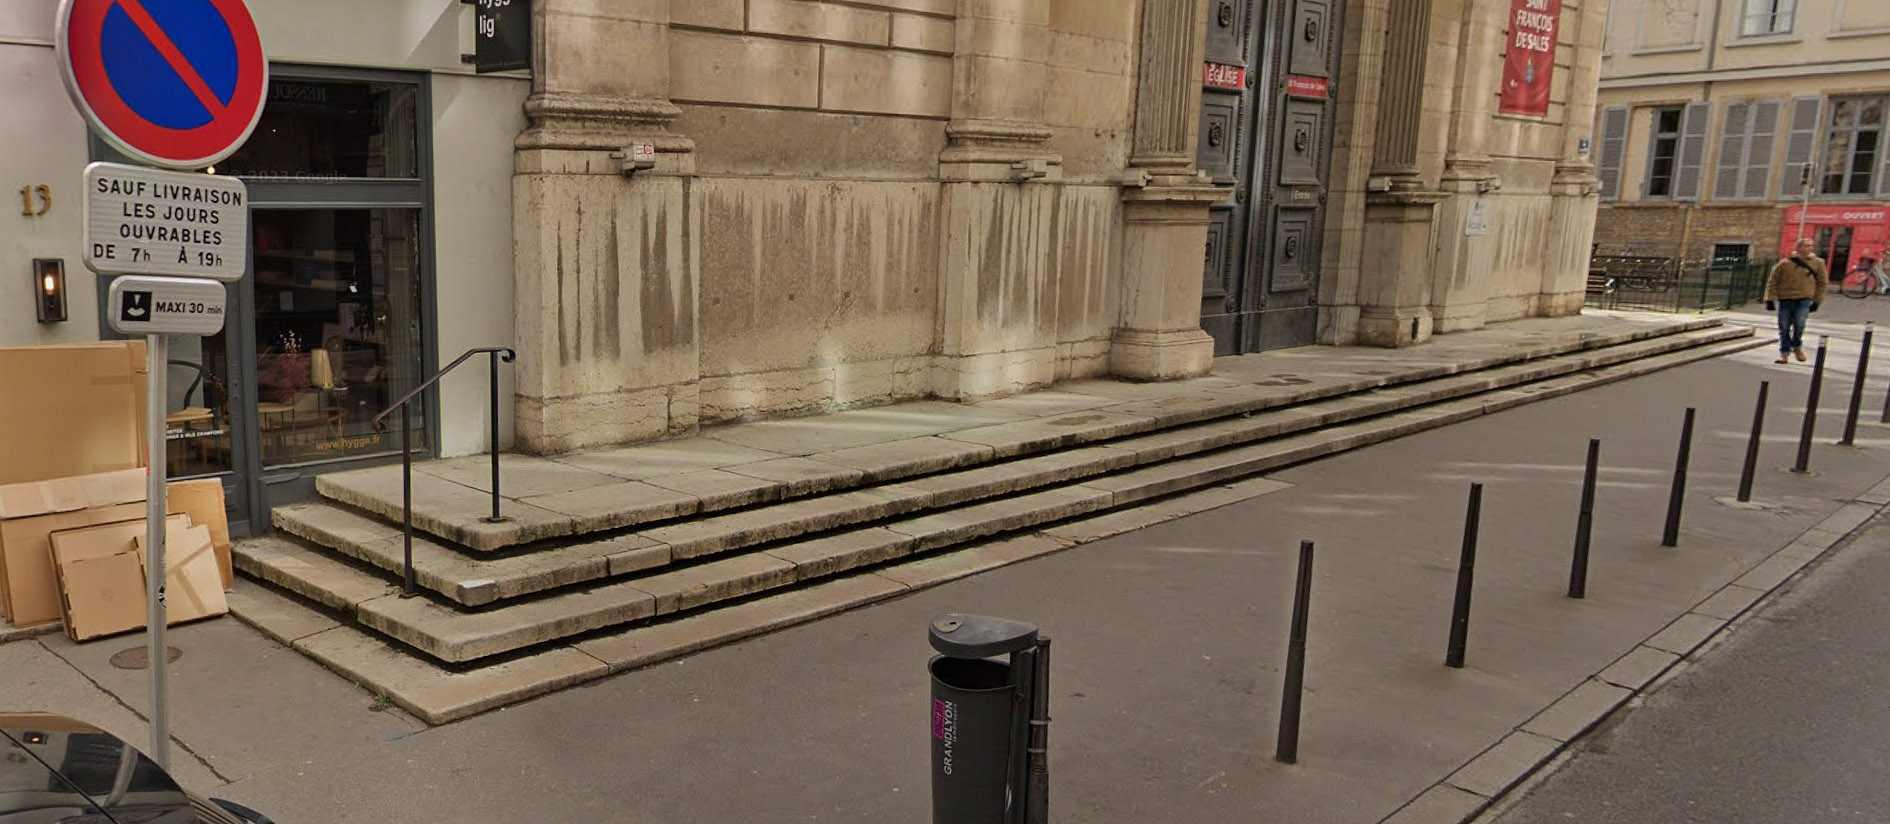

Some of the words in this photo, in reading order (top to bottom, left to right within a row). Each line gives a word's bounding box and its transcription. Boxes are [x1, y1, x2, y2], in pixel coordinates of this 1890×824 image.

[480, 15, 494, 37] lig
[1516, 10, 1554, 32] FRANÇOIS
[20, 184, 52, 216] 13
[98, 178, 146, 196] SAUF
[153, 183, 242, 206] LIVRAISON
[123, 202, 155, 218] LES
[163, 206, 219, 224] JOURS
[120, 223, 222, 245] OUVRABLES
[93, 243, 115, 259] DE
[131, 248, 150, 263] 7h
[178, 246, 187, 264] À
[198, 252, 222, 267] 19h
[155, 301, 185, 313] MAXI
[189, 302, 204, 314] 30
[207, 306, 222, 314] min
[944, 701, 953, 775] GRANDLYON
